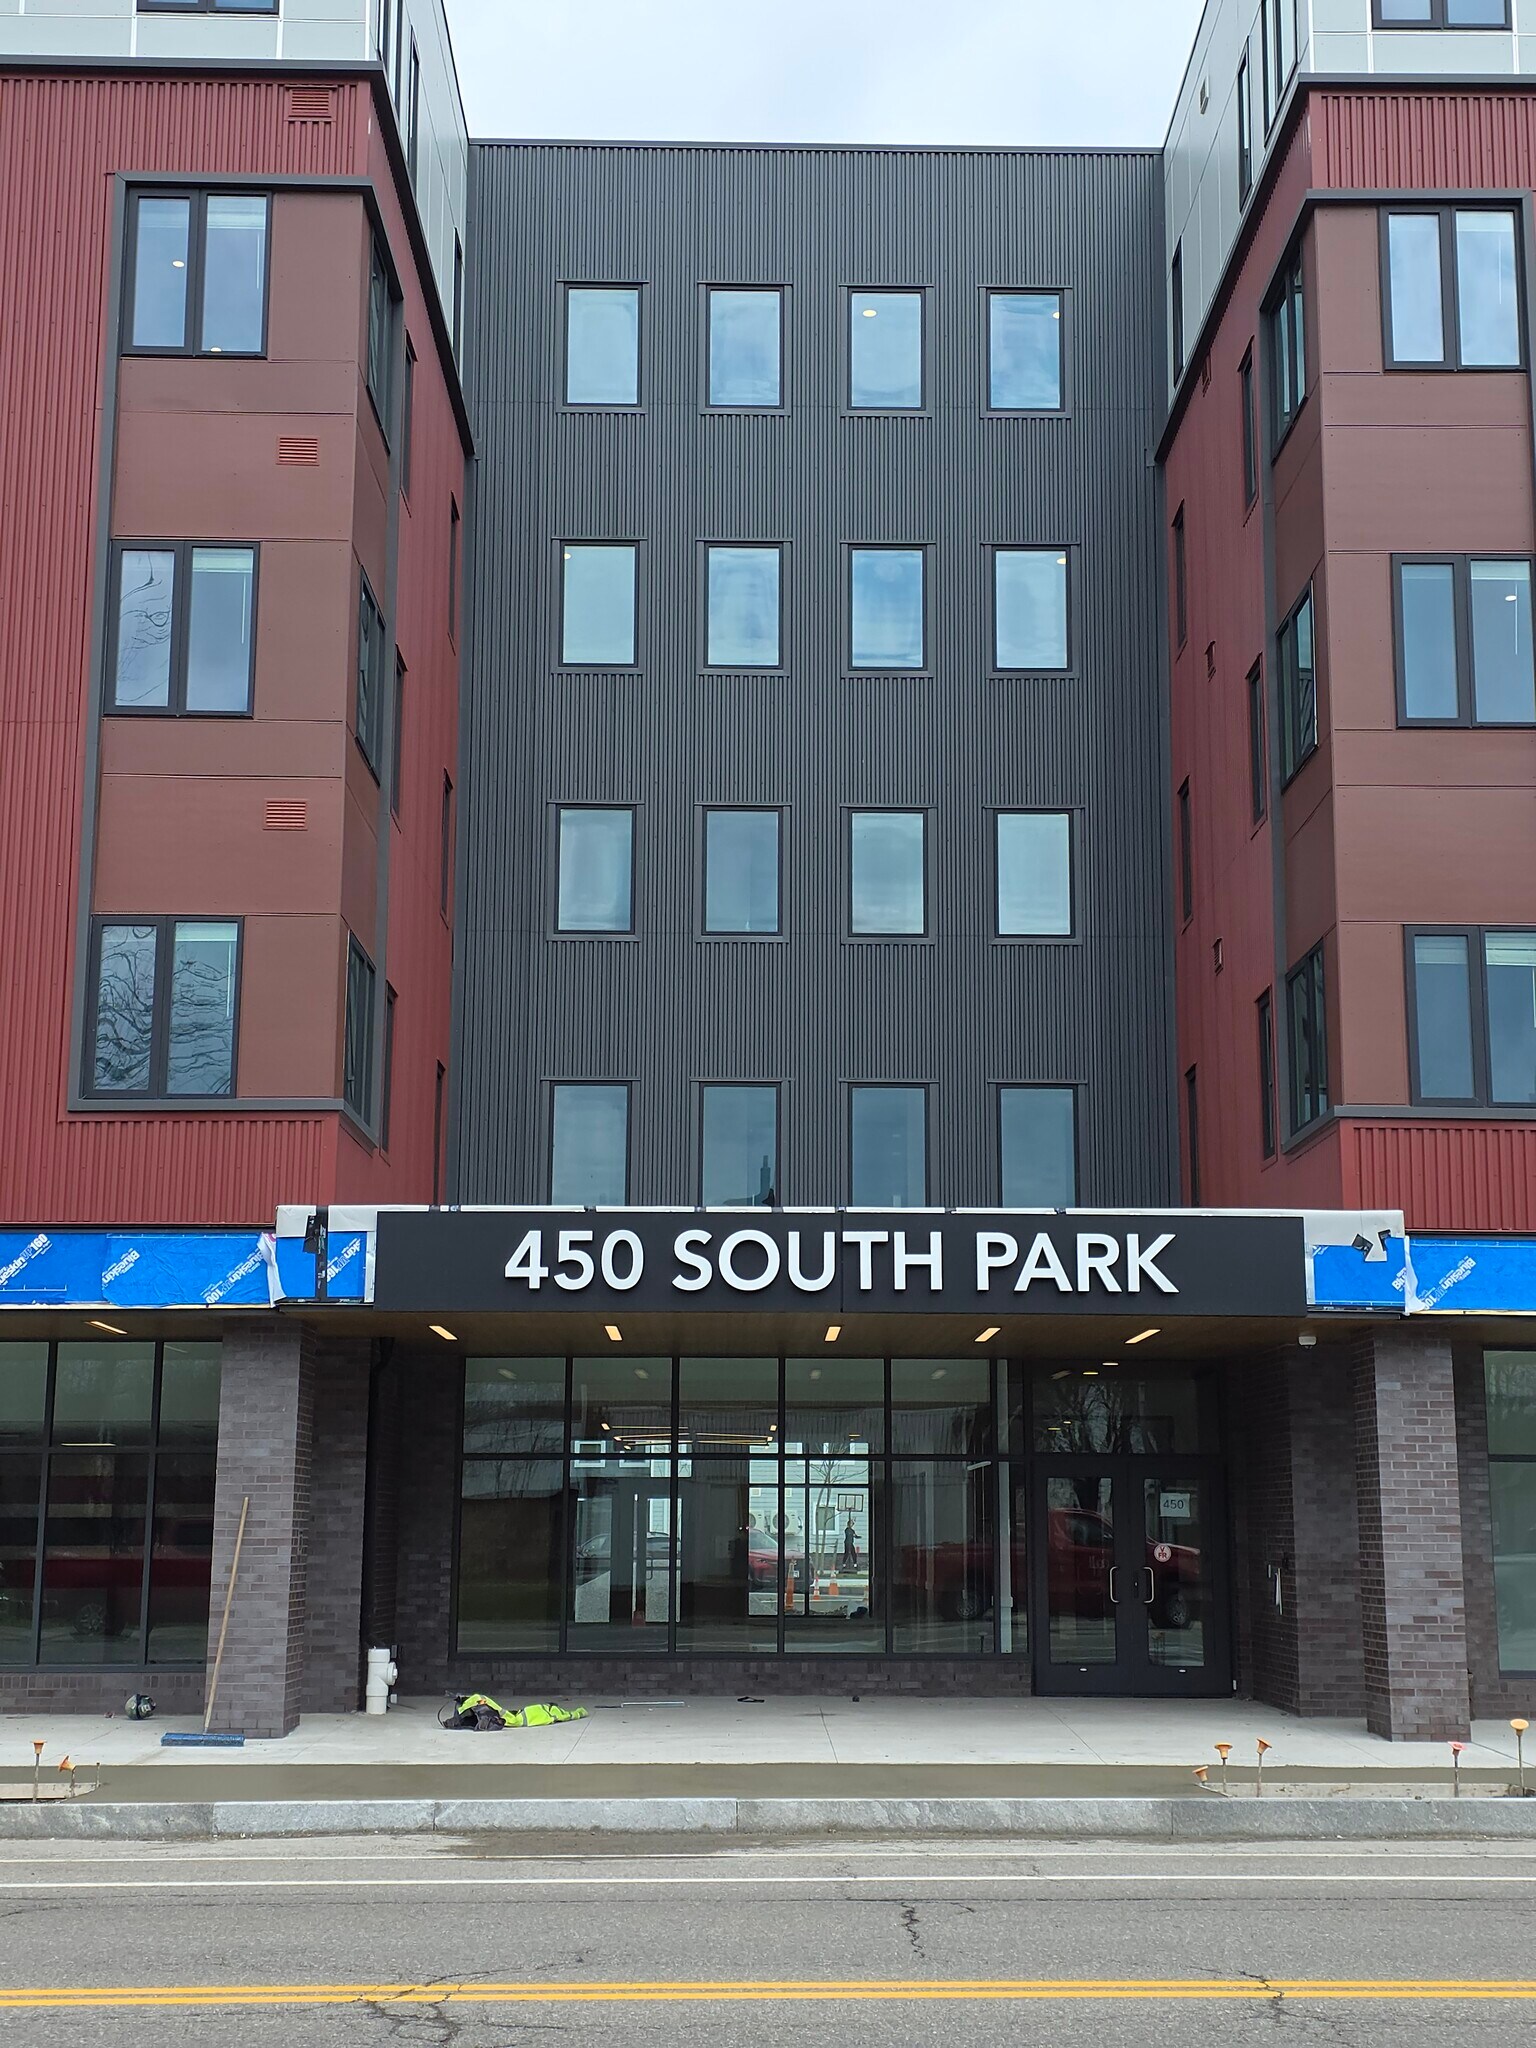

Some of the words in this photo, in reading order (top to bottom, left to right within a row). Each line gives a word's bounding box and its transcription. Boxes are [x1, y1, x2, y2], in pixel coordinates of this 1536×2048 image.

[504, 1229, 644, 1291] 450
[671, 1229, 943, 1292] SOUTH
[976, 1231, 1180, 1293] PARK
[1163, 1499, 1184, 1510] 450
